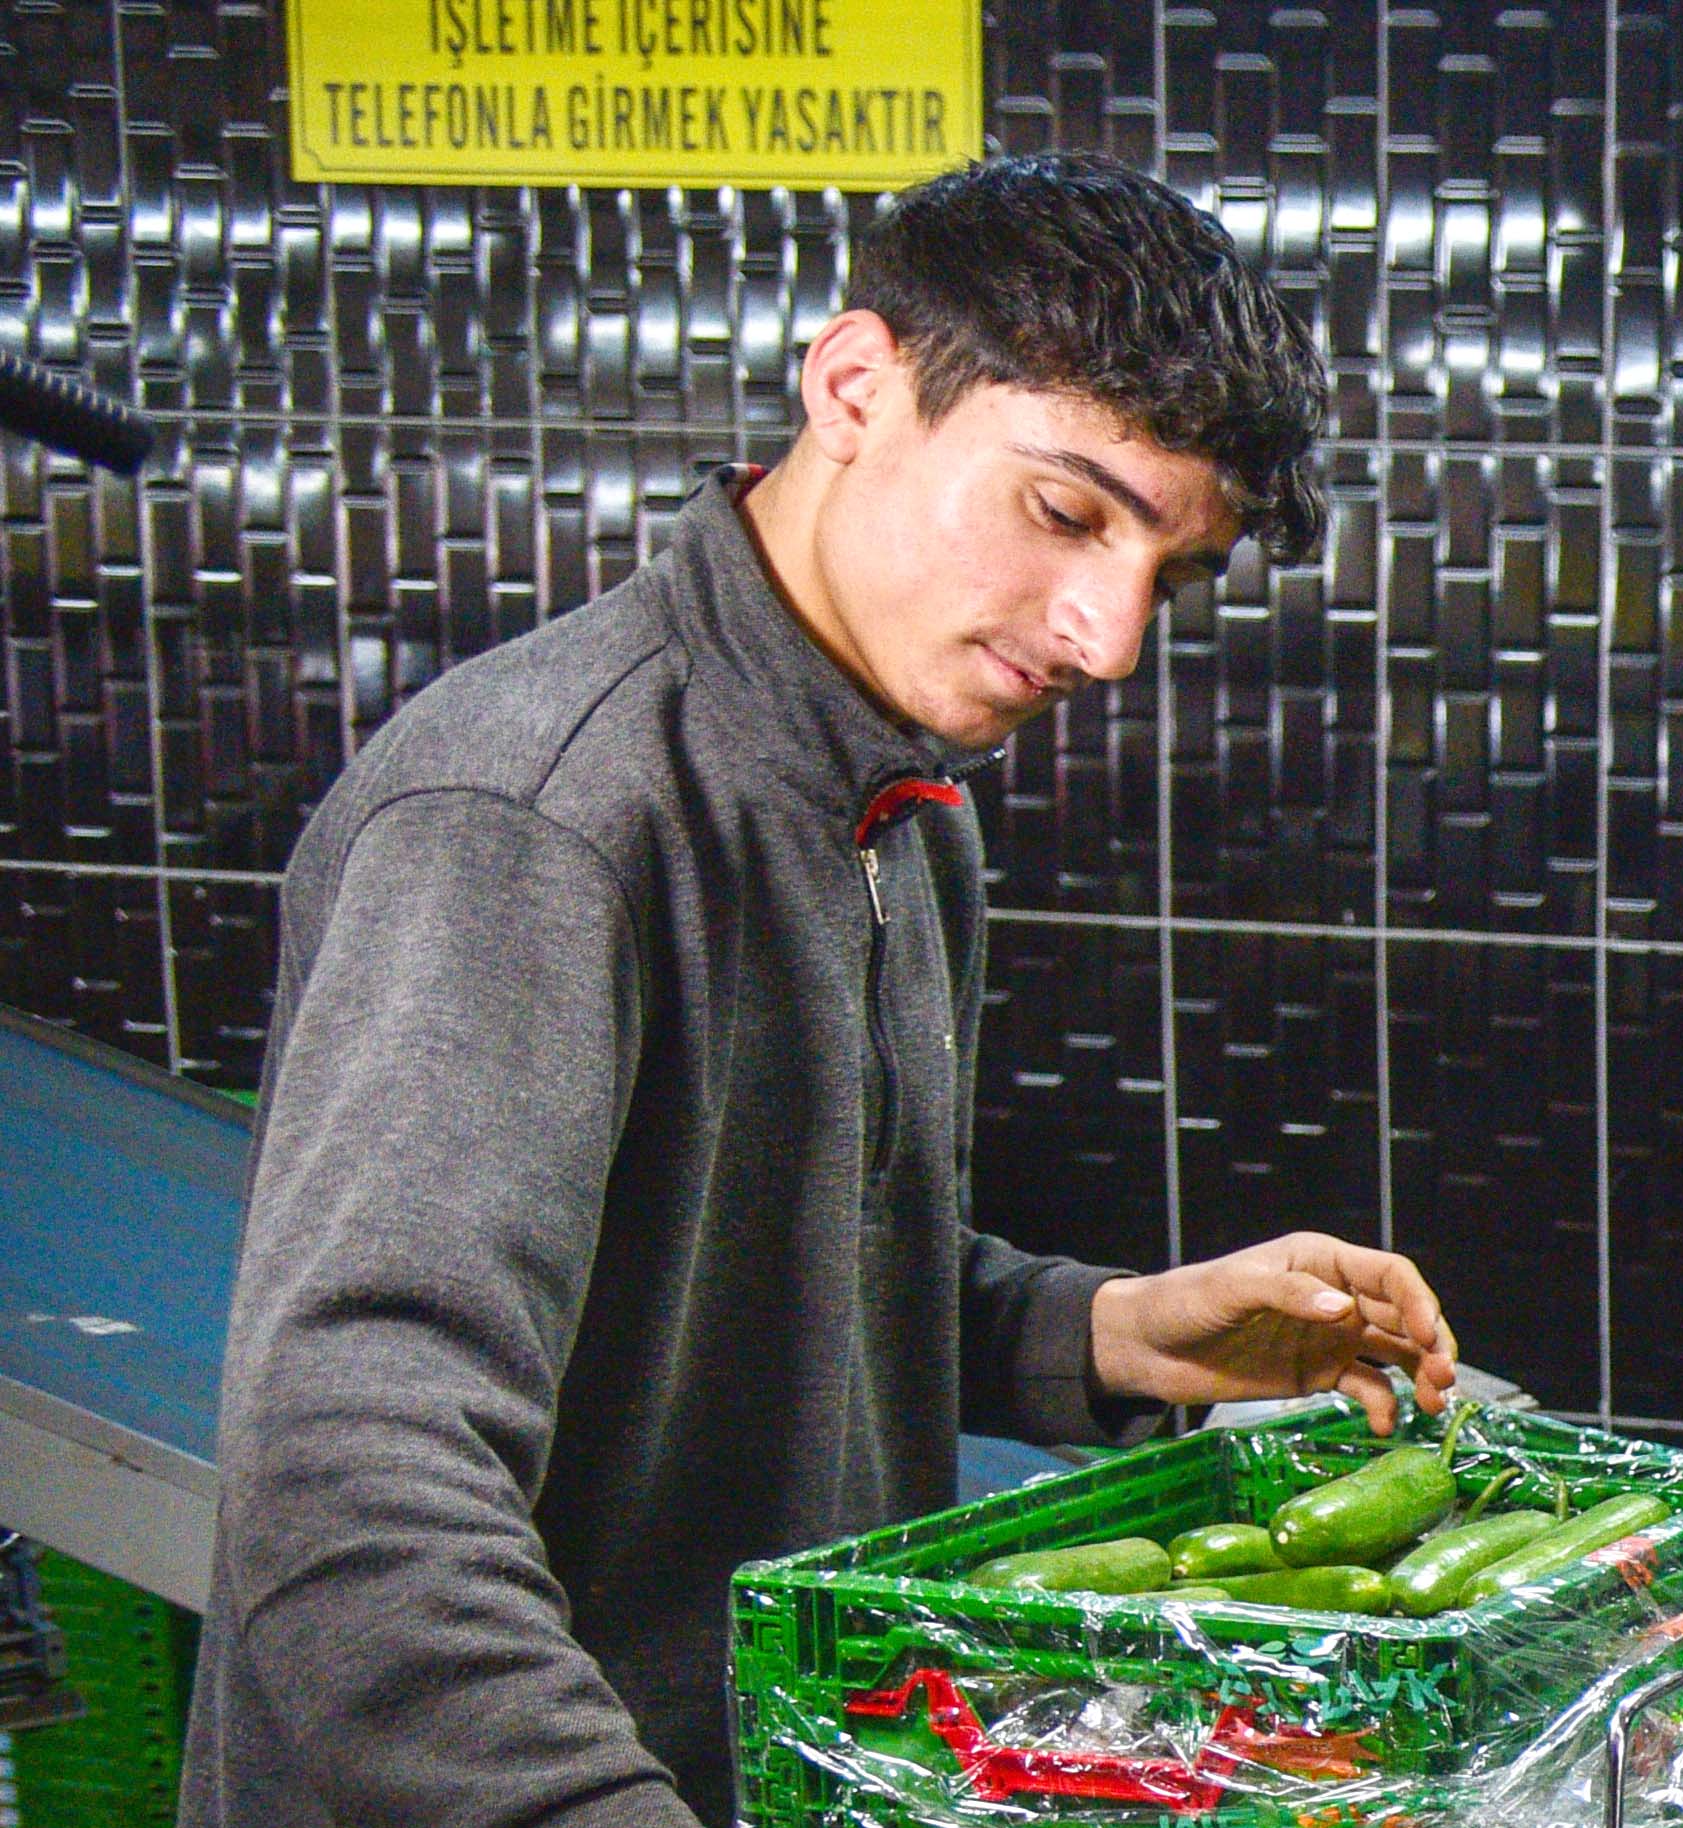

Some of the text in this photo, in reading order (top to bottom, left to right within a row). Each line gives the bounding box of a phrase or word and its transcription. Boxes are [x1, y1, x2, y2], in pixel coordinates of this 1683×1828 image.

[323, 74, 947, 156] TELEFONLA GİRMEK YASAKTIR
